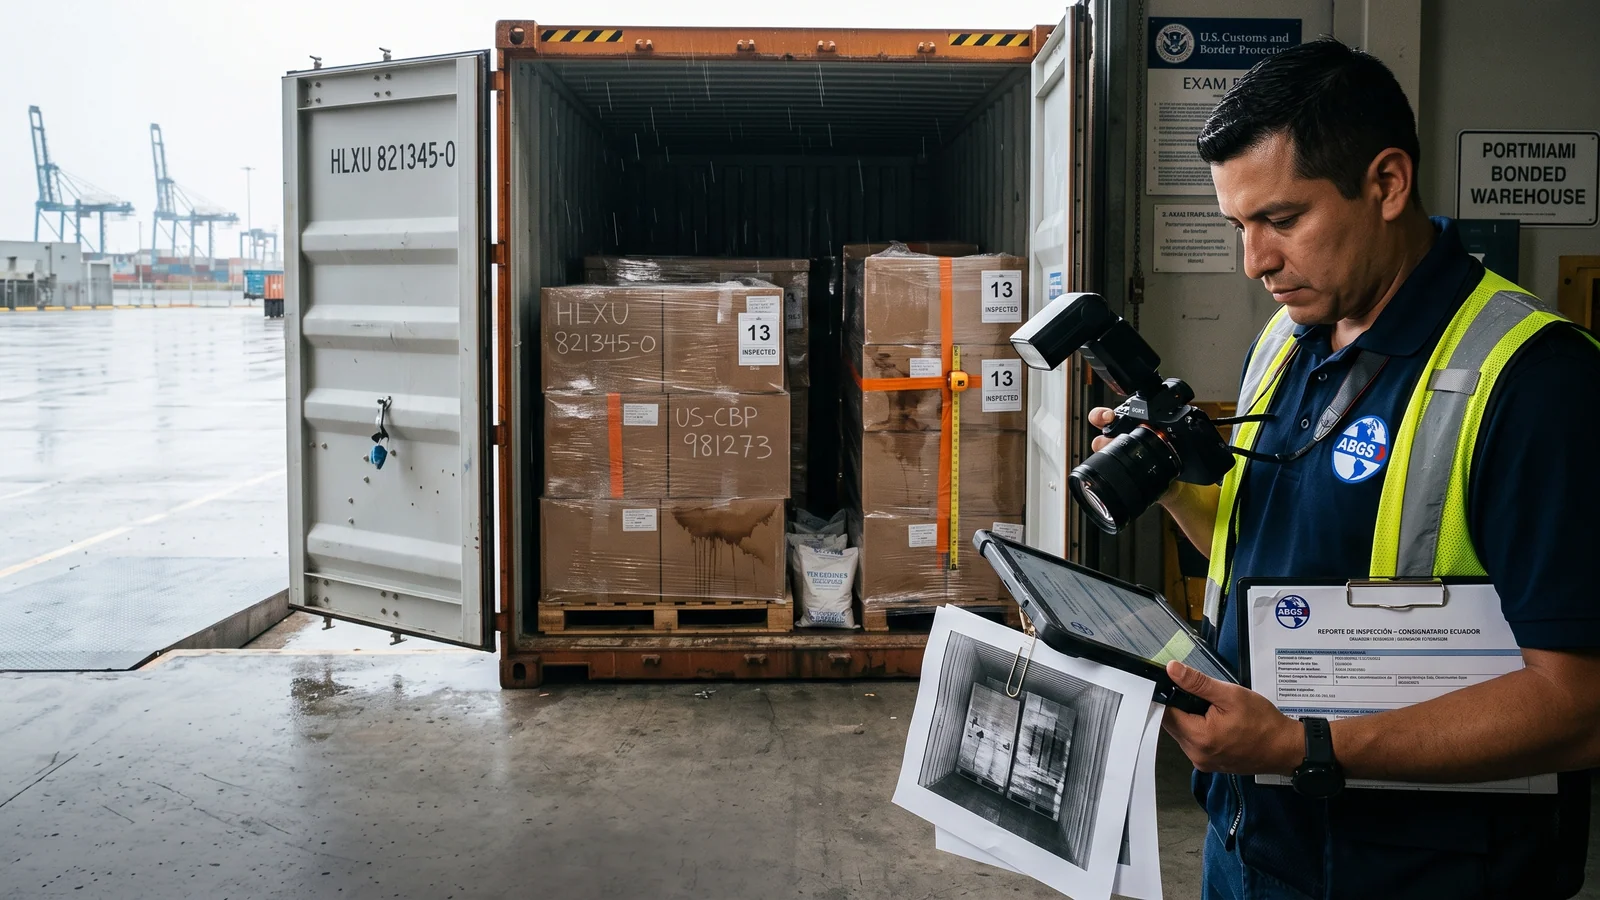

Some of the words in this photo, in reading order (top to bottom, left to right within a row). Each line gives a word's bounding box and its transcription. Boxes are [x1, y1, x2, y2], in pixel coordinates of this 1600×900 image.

[1200, 32, 1220, 42] U.S.
[1222, 33, 1266, 43] Customs
[1269, 33, 1290, 43] and
[1200, 45, 1236, 54] Border
[1183, 77, 1226, 90] EXAM
[331, 146, 372, 174] HLXU
[377, 140, 456, 172] 821345-0
[1483, 142, 1576, 159] PORTMIAMI
[1491, 166, 1567, 182] BONDED
[1470, 188, 1586, 205] WAREHOUSE
[991, 281, 1013, 298] 13
[556, 301, 630, 326] HLXU
[747, 324, 771, 341] 13
[554, 331, 656, 355] 821345-0
[742, 348, 777, 356] INSPECTED
[991, 370, 1014, 387] 13
[985, 394, 1019, 402] INSPECTED
[675, 406, 759, 429] US-CBP
[683, 432, 773, 460] 981273
[1355, 627, 1393, 635] INSPECCIÓN
